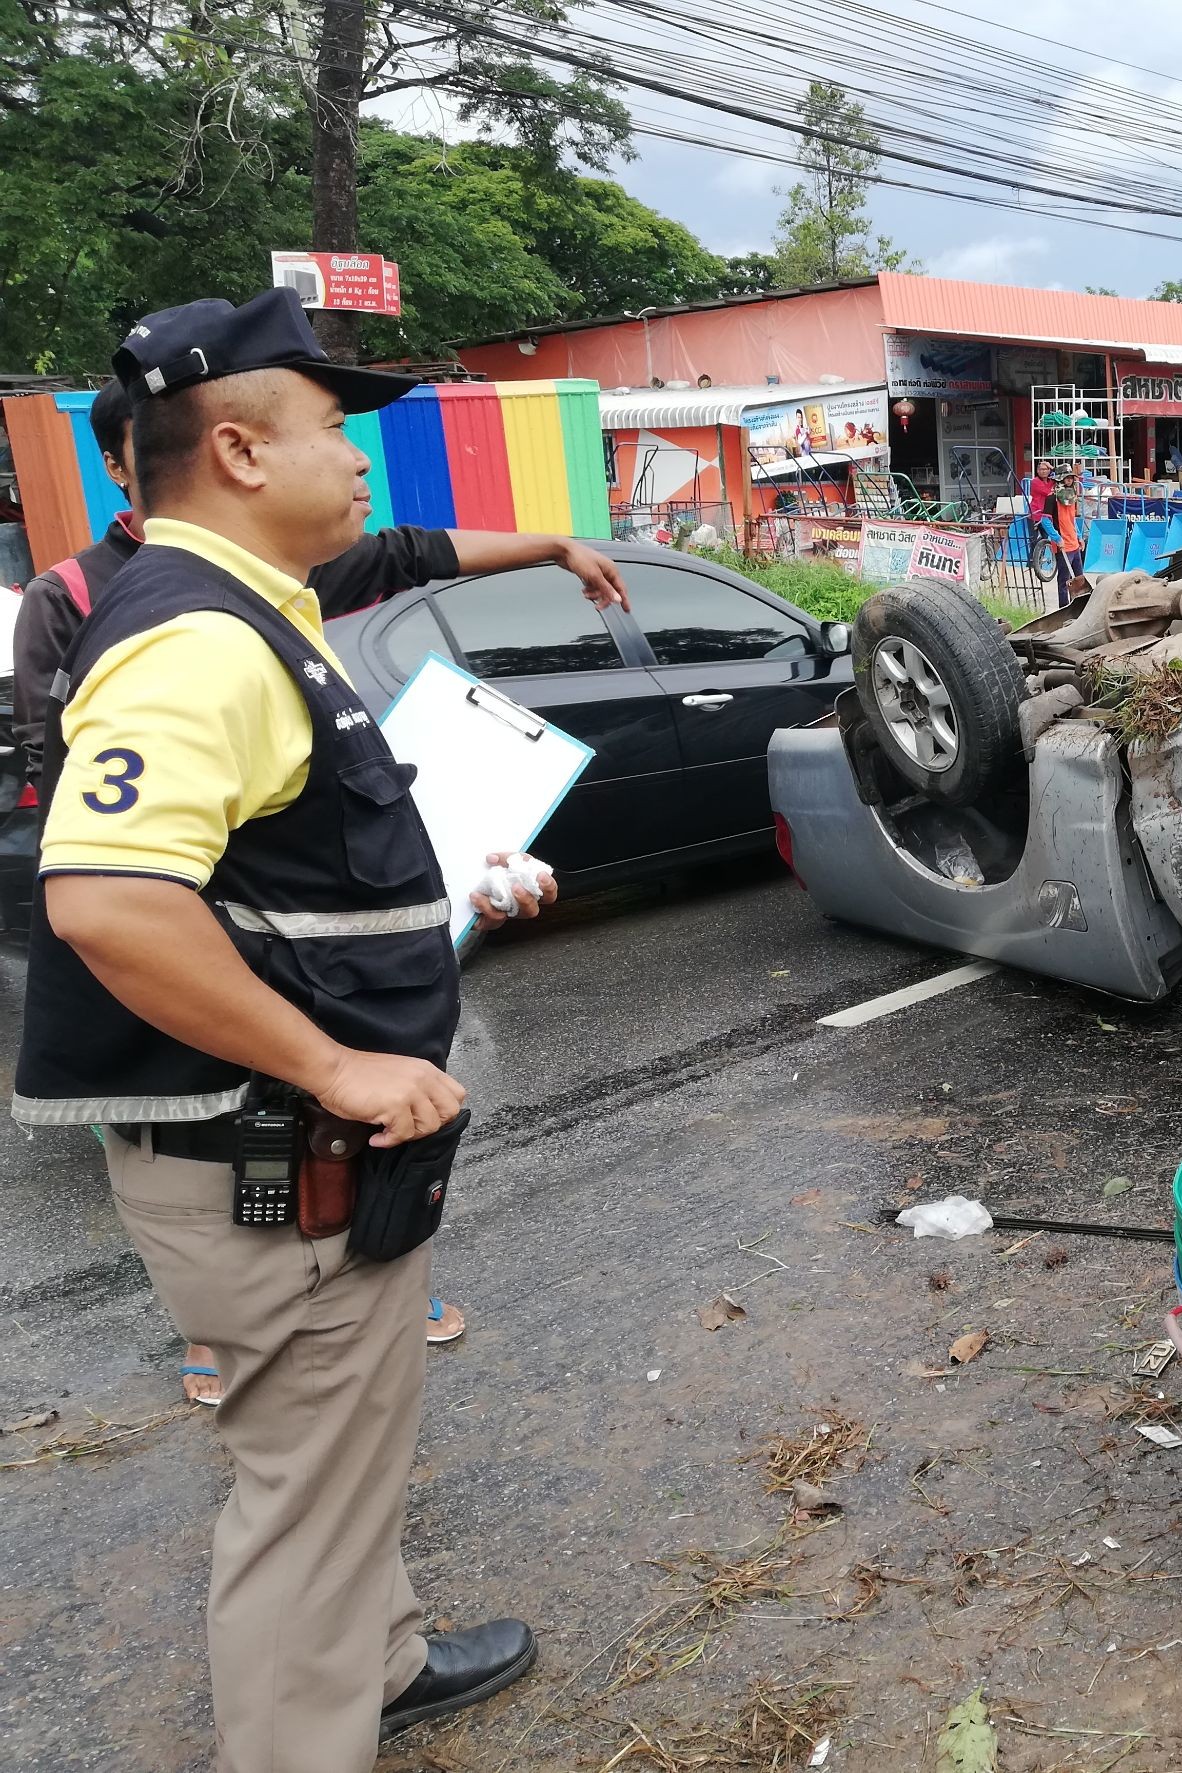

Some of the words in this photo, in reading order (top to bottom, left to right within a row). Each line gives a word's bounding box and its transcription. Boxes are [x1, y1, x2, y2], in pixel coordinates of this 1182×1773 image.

[866, 529, 897, 543] สหชาติ
[897, 530, 916, 544] วัสด
[82, 747, 145, 815] 3
